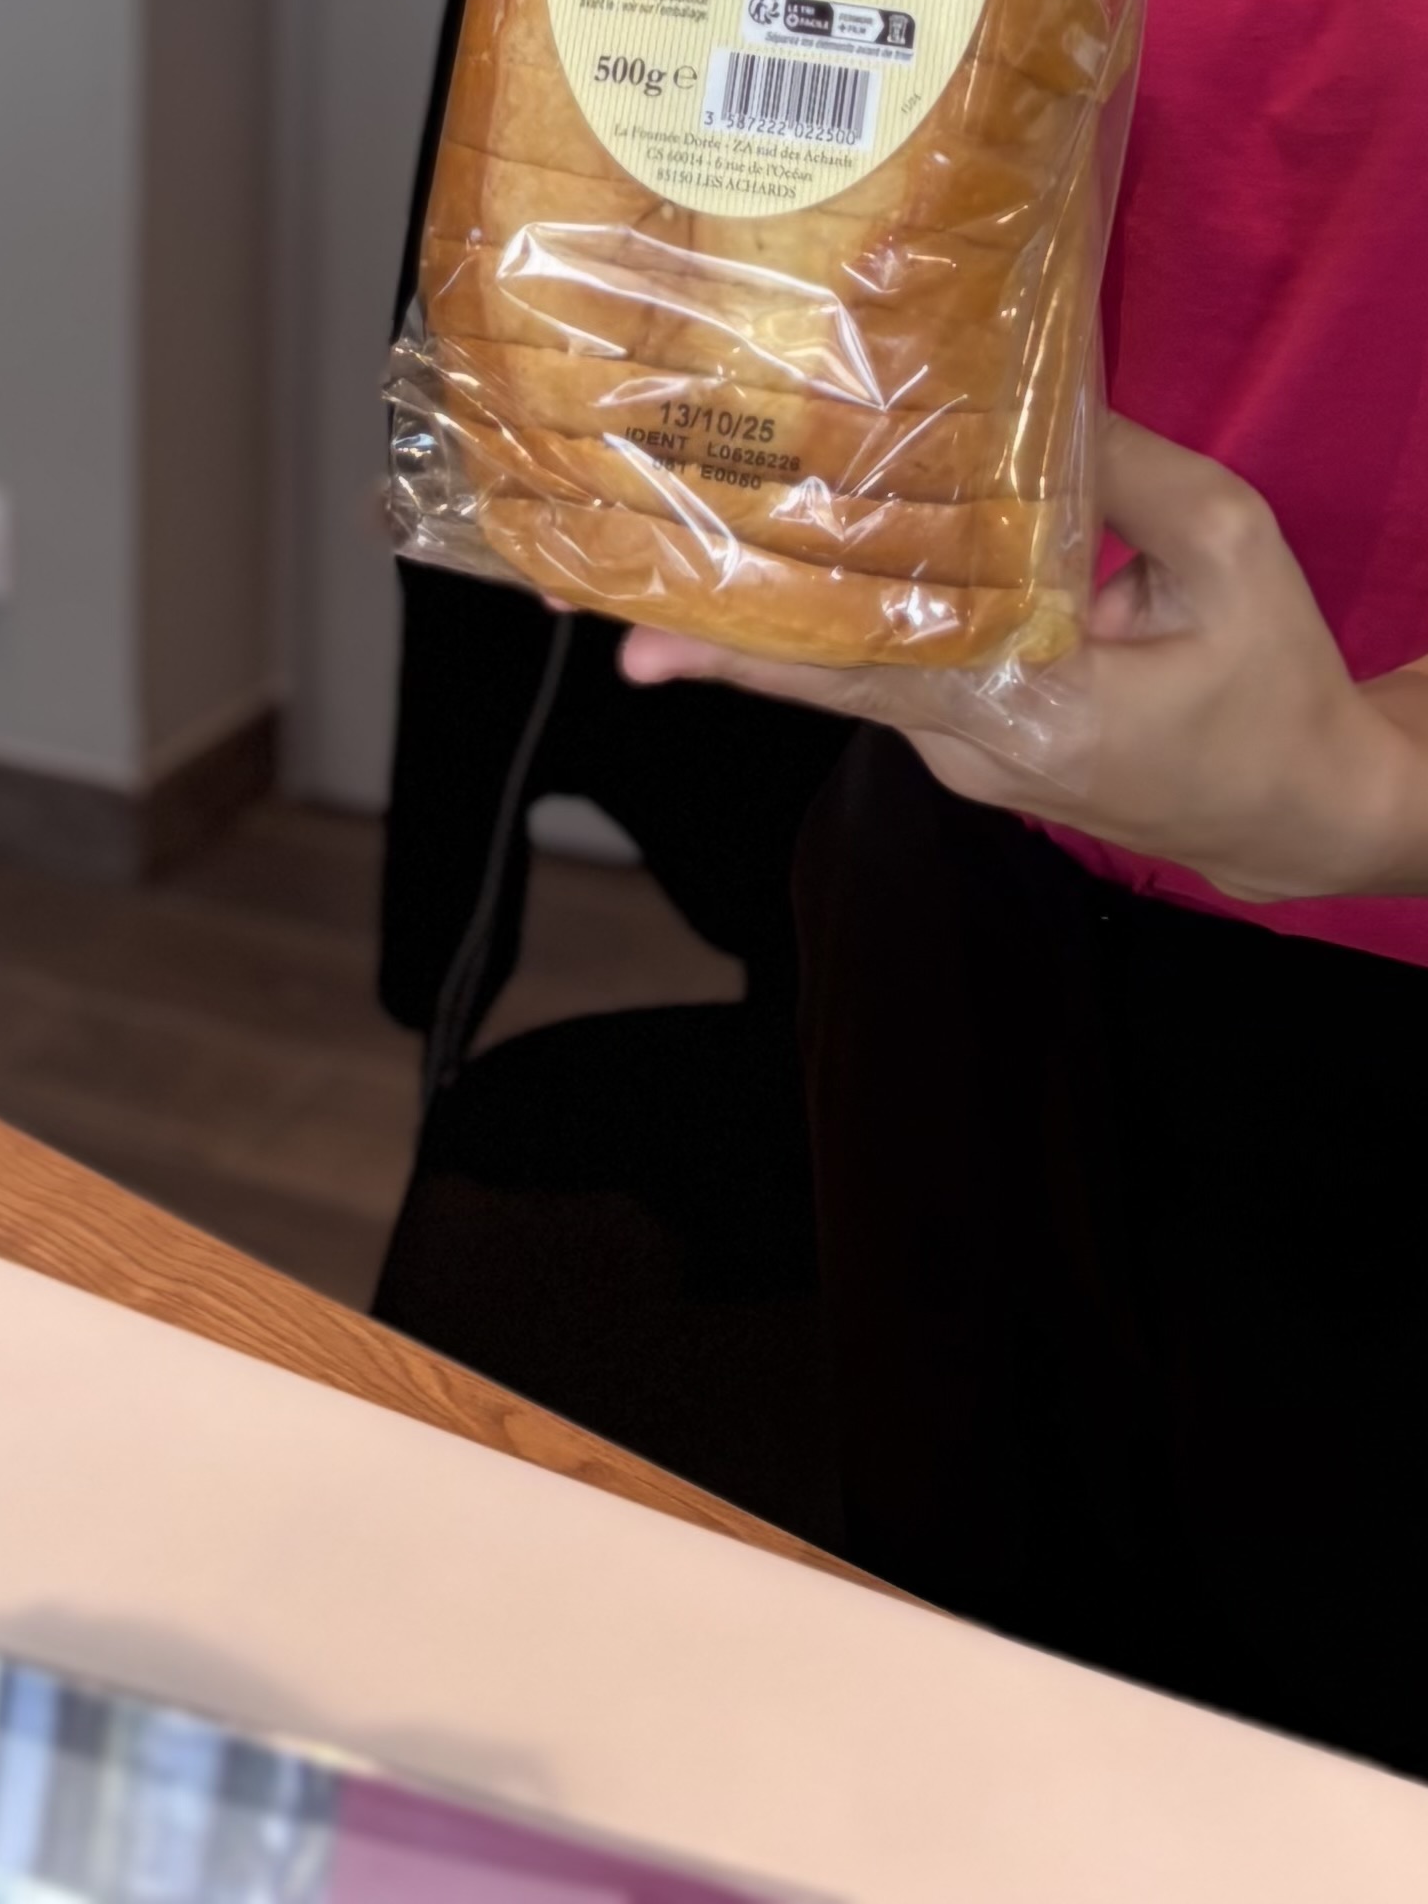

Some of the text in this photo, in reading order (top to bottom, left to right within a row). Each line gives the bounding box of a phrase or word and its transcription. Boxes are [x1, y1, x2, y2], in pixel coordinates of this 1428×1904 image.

[594, 54, 667, 98] 500g
[704, 110, 715, 126] 3
[794, 123, 857, 146] 022500
[646, 146, 664, 162] CS
[748, 161, 762, 175] de
[733, 139, 752, 154] ZA
[695, 172, 723, 190] LES
[725, 177, 797, 200] ACHARDS
[660, 400, 776, 443] 13/10/25
[625, 426, 689, 450] IDENT
